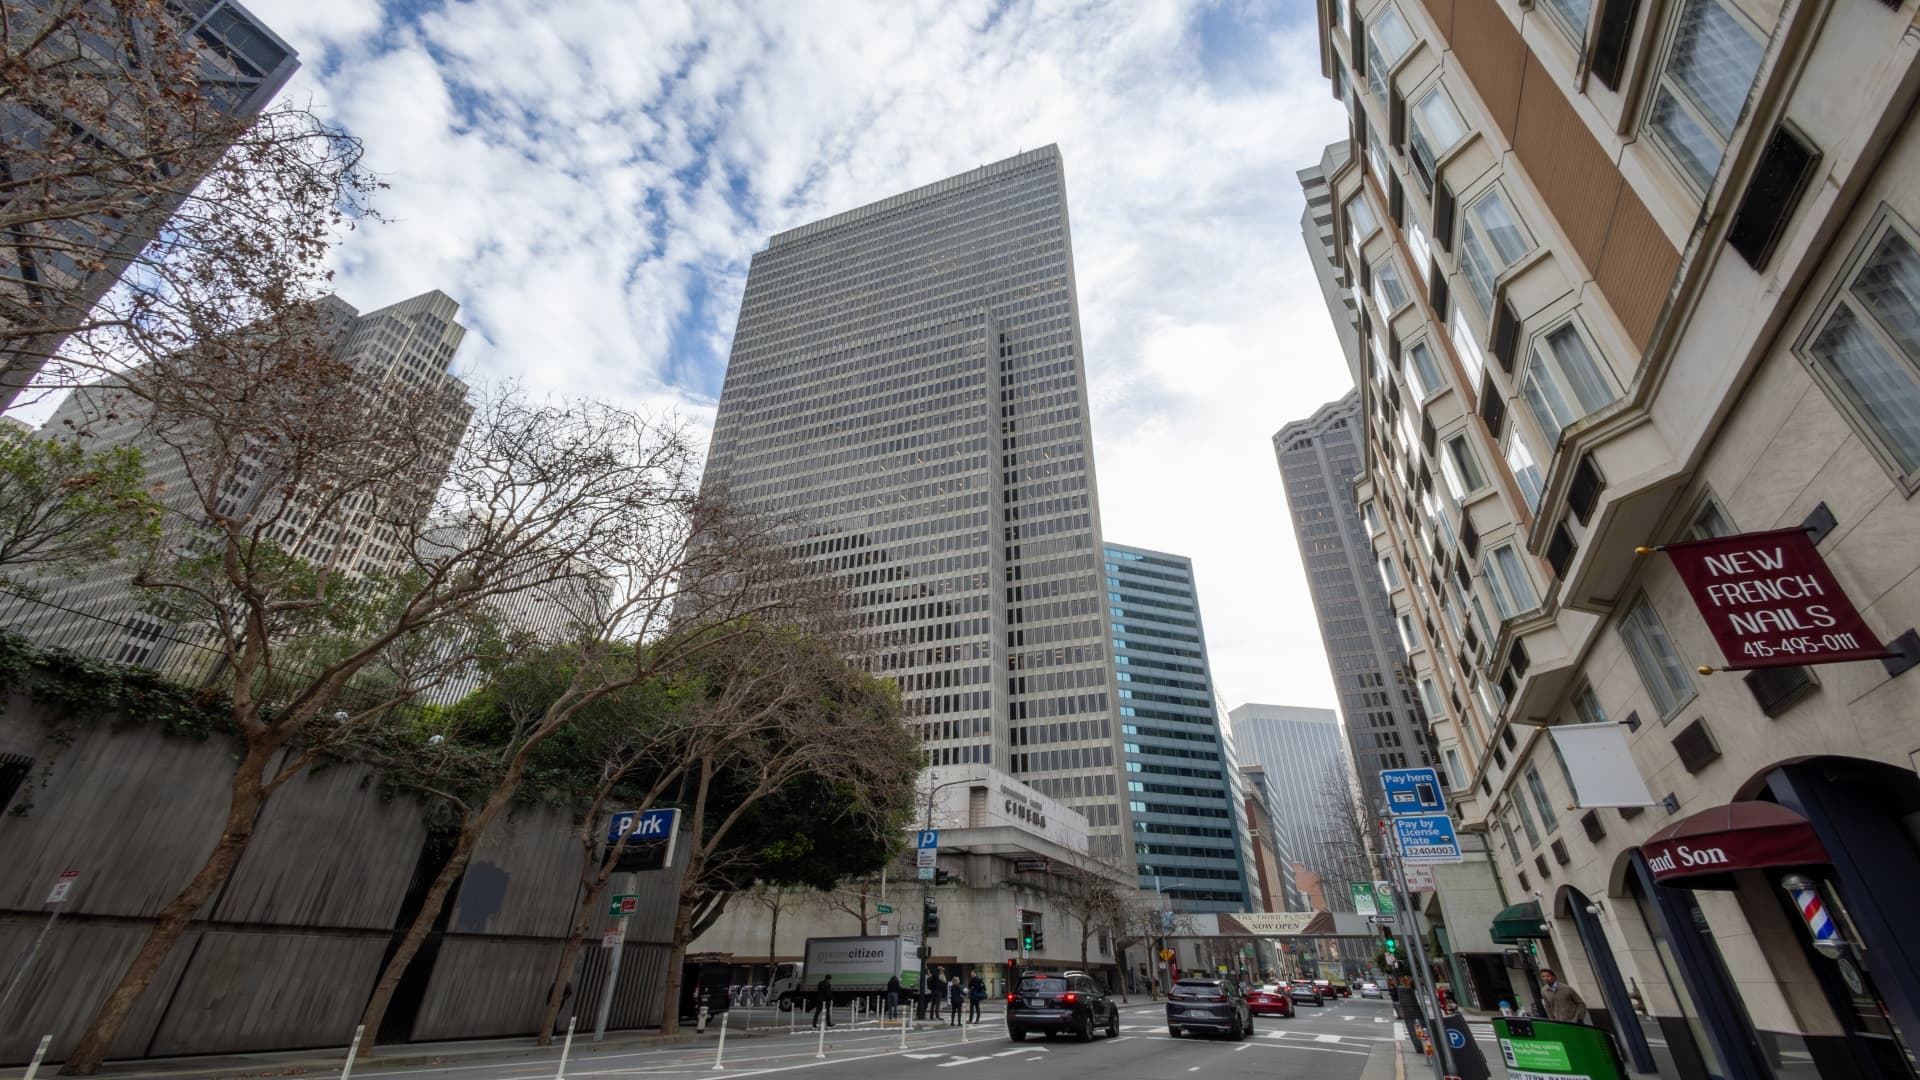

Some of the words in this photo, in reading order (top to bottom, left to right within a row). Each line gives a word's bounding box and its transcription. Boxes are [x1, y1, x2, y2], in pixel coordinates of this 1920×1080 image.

[1704, 547, 1784, 577] NEW
[1706, 574, 1825, 607] FRENCH
[1728, 605, 1837, 635] NAILS
[1743, 632, 1860, 658] 415-495-0111
[1385, 775, 1406, 784] Pay
[1407, 773, 1433, 782] here
[1005, 799, 1047, 828] CINEMA
[1398, 820, 1417, 829] Pay
[1420, 819, 1434, 829] by
[617, 814, 664, 836] Park
[1400, 828, 1440, 837] License
[1403, 836, 1431, 845] Plate
[1407, 846, 1455, 856] 32404003
[1649, 848, 1677, 873] and
[1677, 845, 1729, 867] Son
[1275, 922, 1300, 930] OPEN
